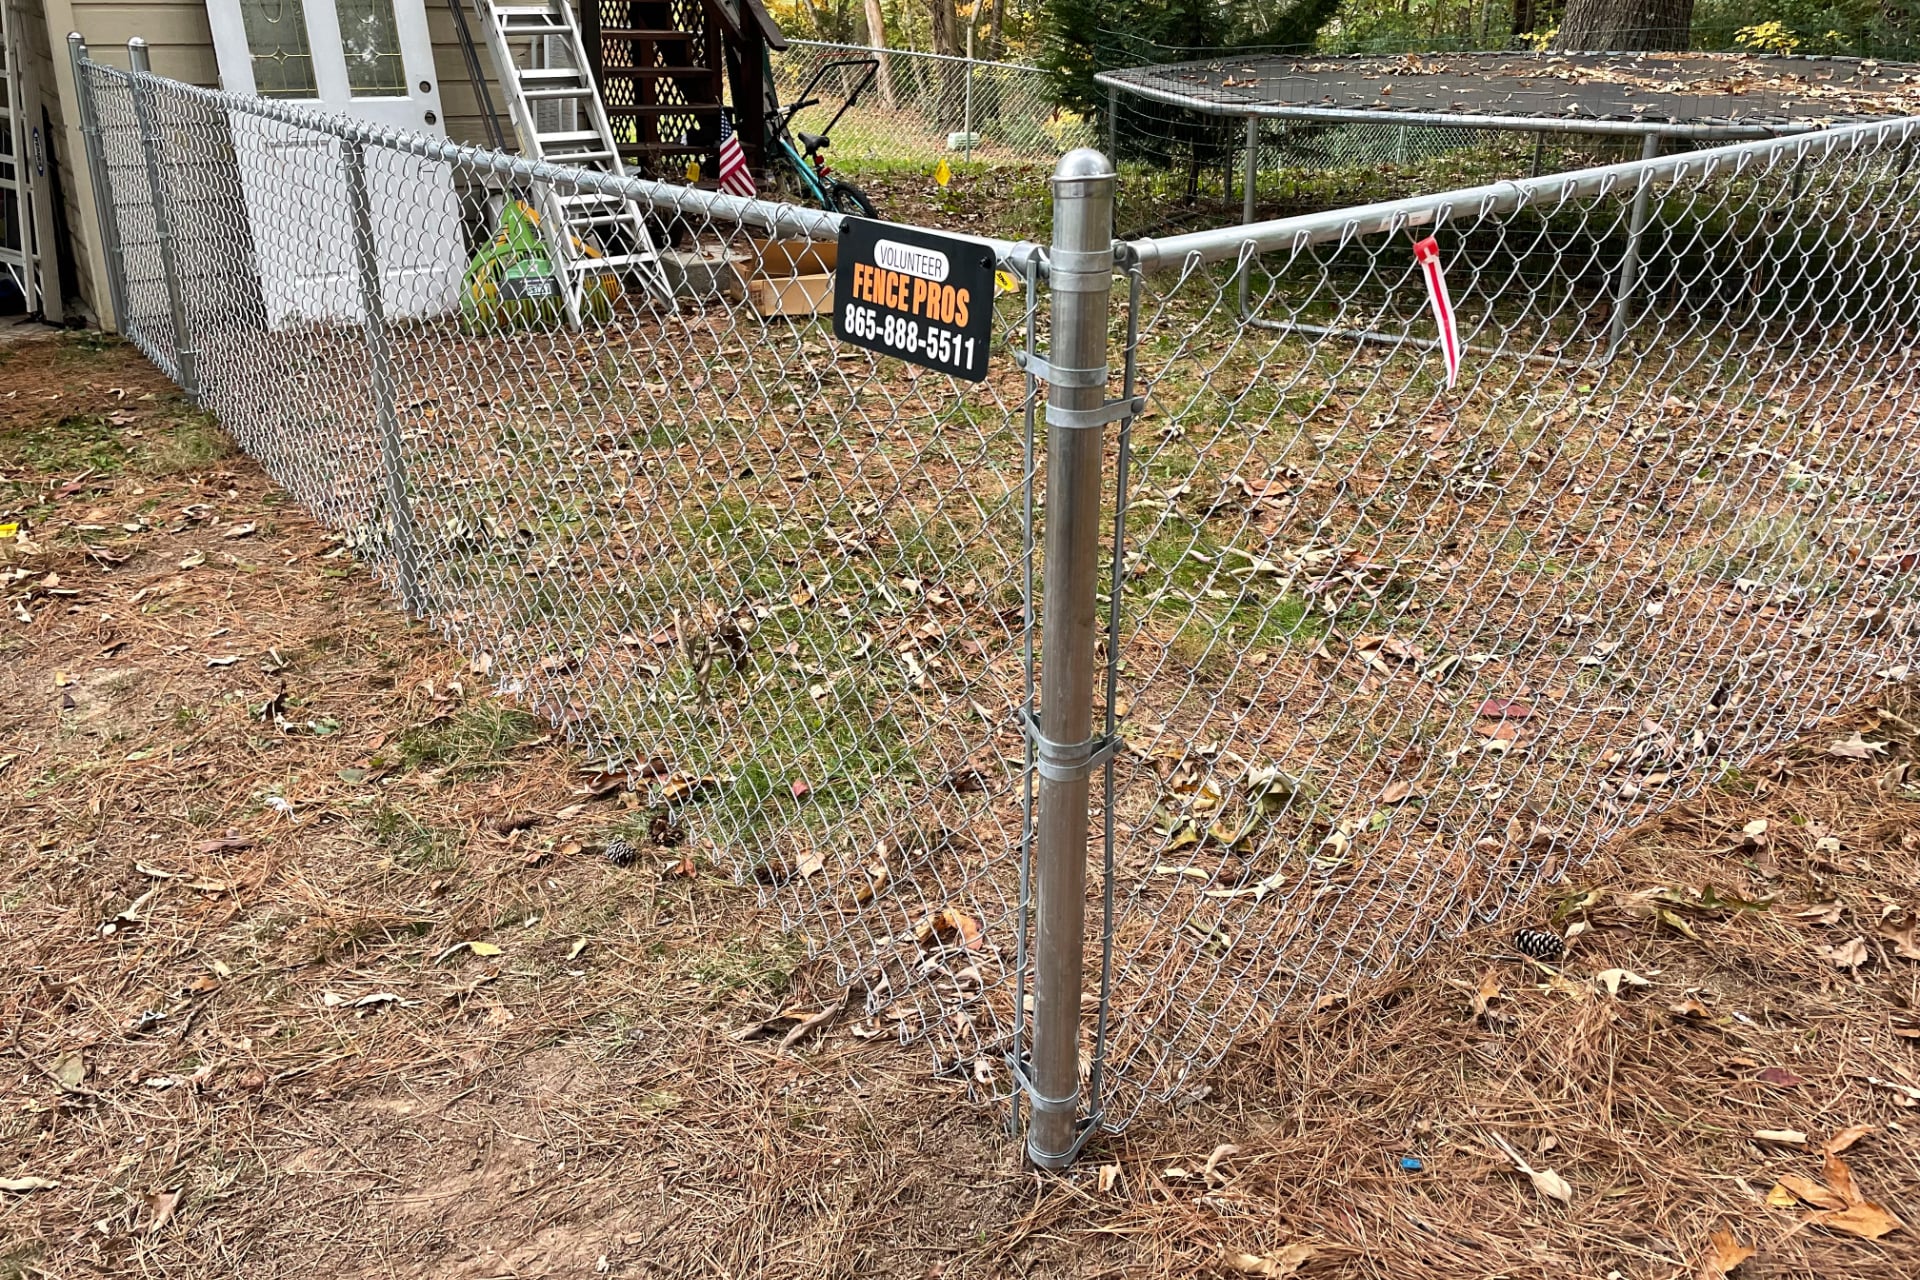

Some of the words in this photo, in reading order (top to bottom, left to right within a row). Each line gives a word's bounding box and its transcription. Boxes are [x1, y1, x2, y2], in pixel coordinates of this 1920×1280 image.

[880, 245, 943, 278] VOLUNTEER
[852, 262, 911, 312] FENCE
[912, 277, 970, 328] PROS
[844, 303, 975, 370] 865-888-5511
